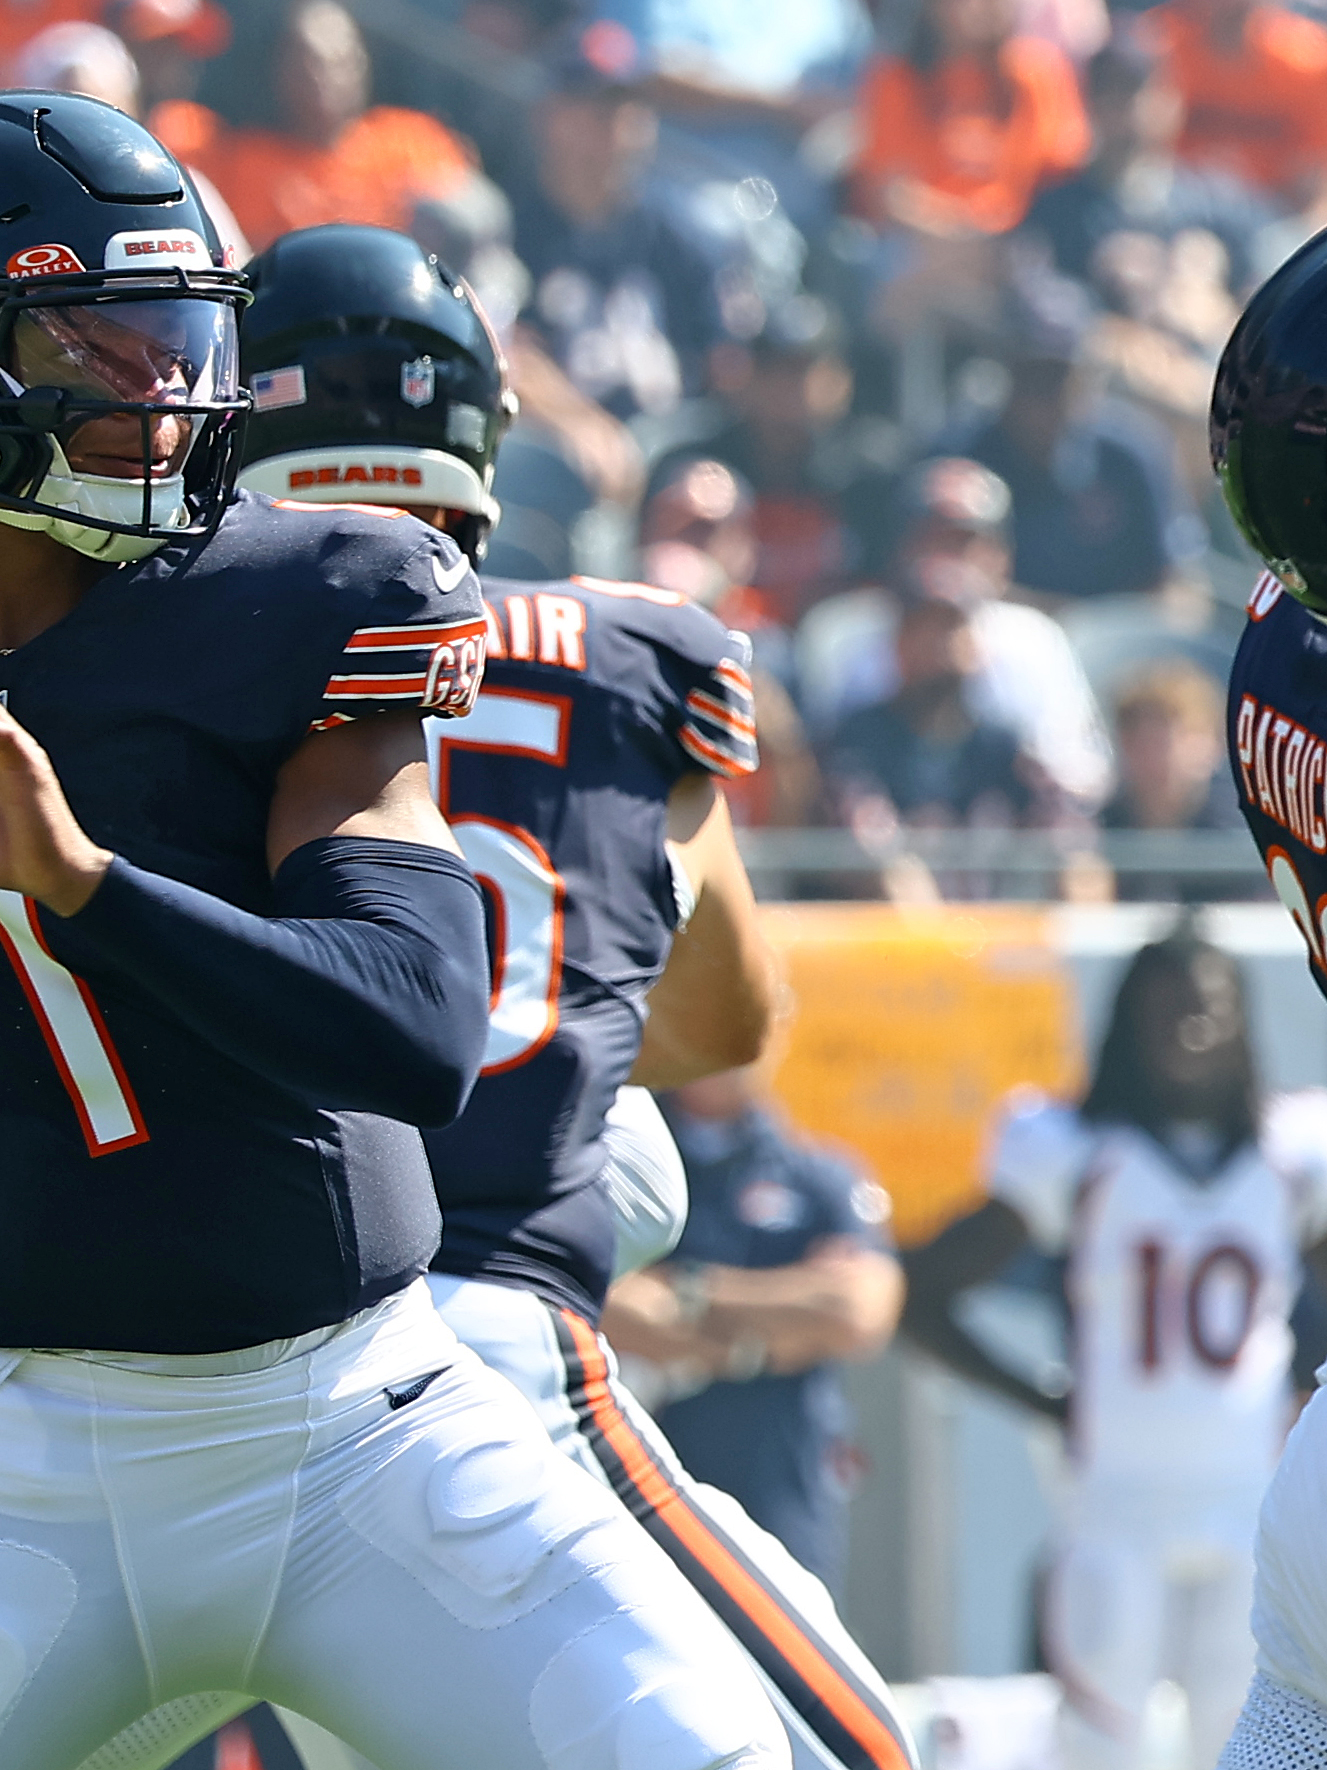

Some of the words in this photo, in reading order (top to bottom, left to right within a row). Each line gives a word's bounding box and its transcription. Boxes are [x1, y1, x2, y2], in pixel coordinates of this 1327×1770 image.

[125, 240, 196, 257] BEARS
[9, 261, 73, 279] OAKLEY
[287, 465, 422, 490] BEARS
[1237, 692, 1327, 855] PATRIC
[1134, 1238, 1266, 1372] 10
